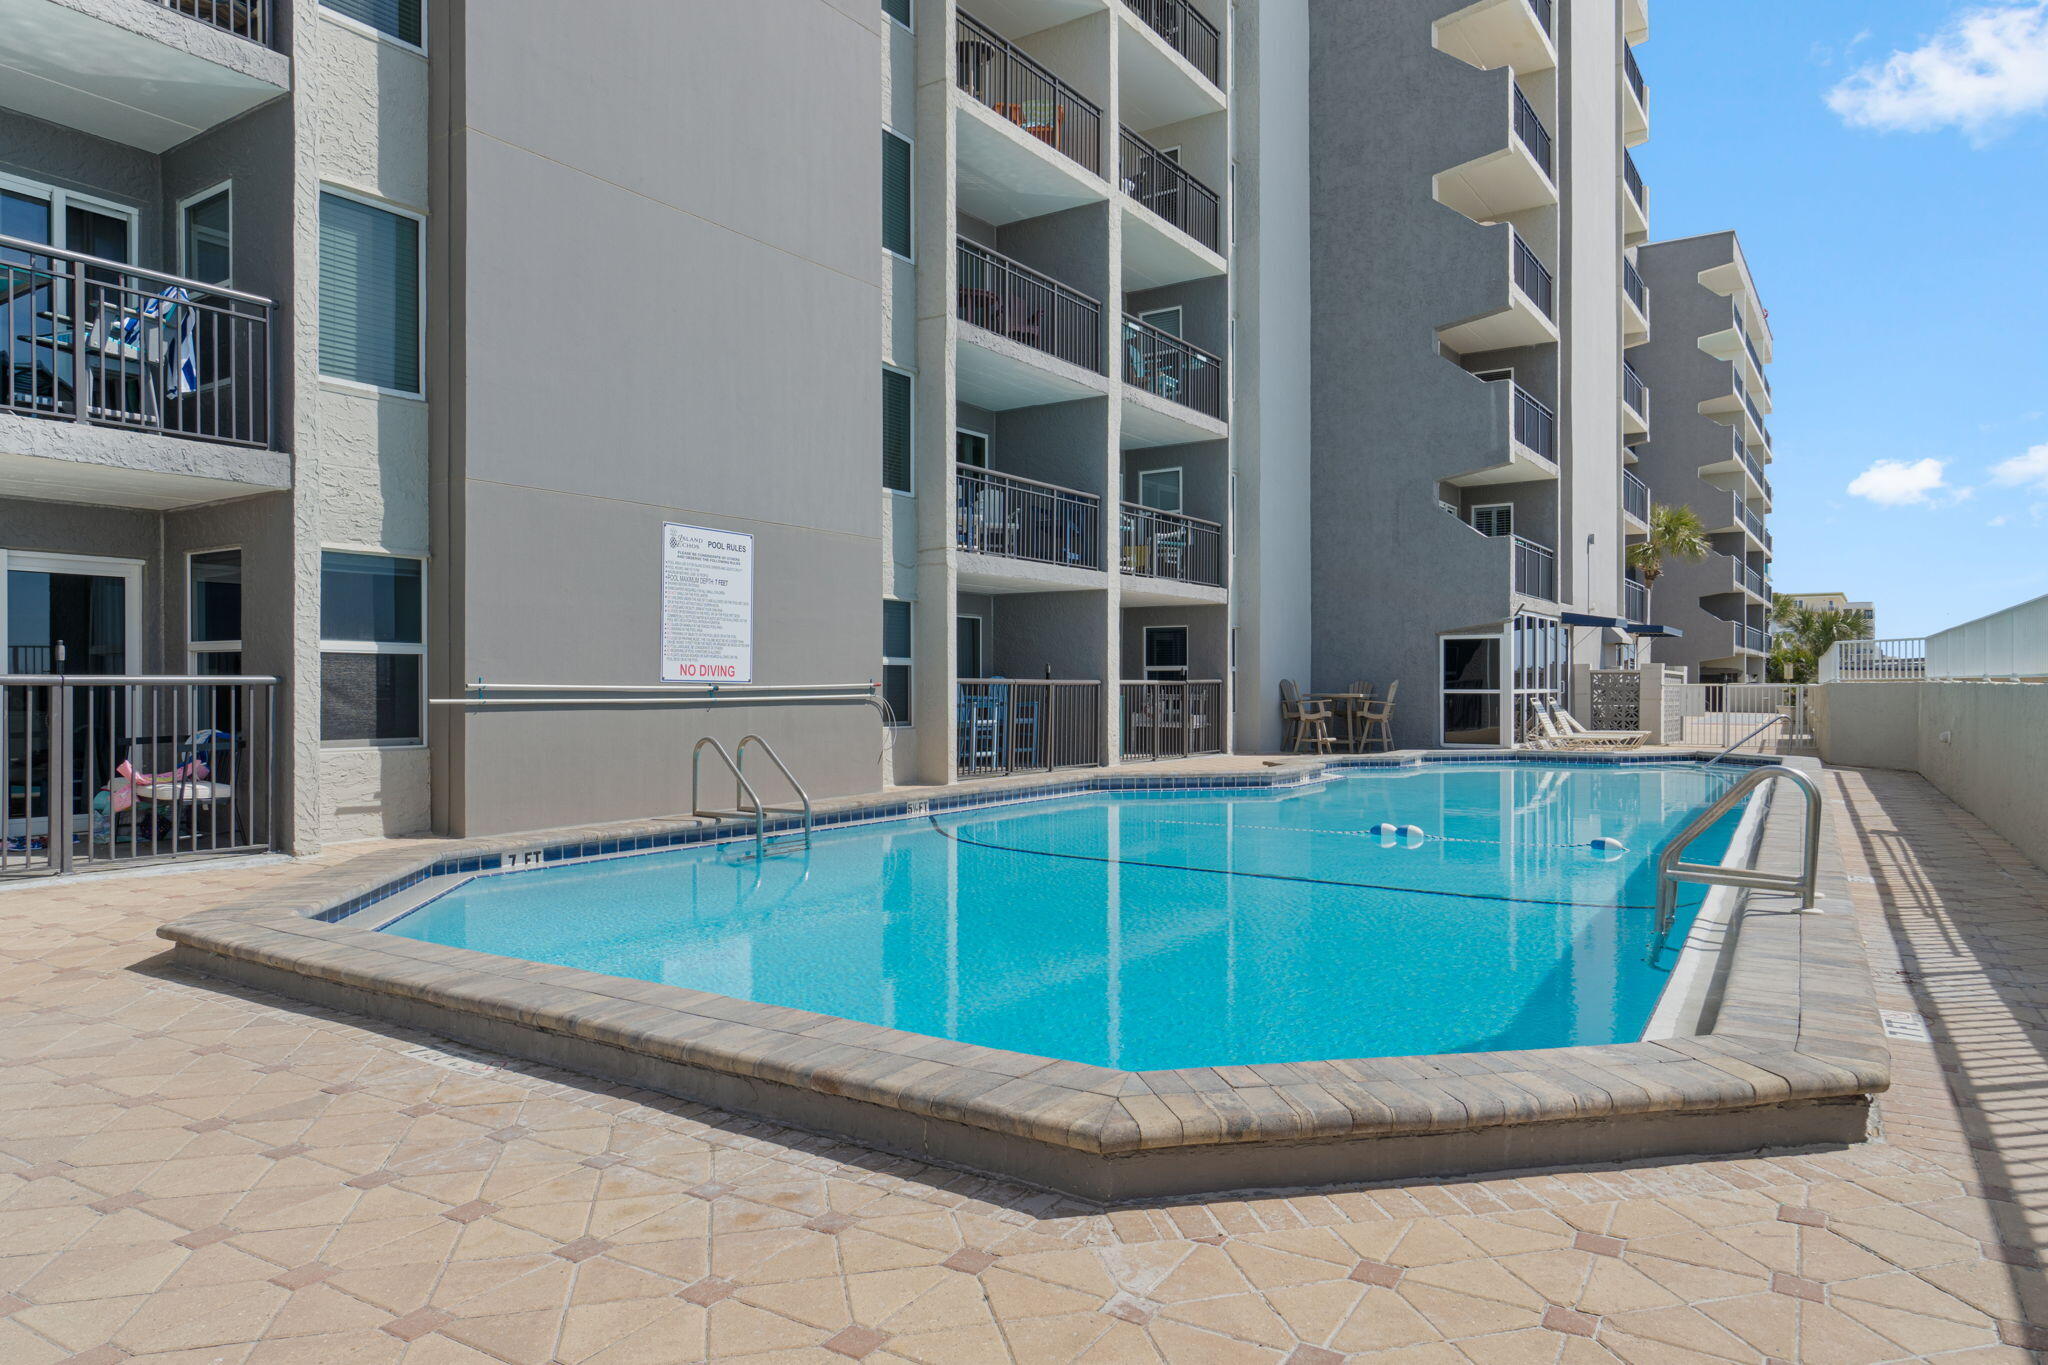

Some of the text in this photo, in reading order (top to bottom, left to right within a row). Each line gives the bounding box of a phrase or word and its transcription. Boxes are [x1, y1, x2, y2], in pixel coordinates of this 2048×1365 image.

[708, 541, 746, 553] POOL RULES
[667, 574, 679, 582] POOL
[680, 575, 699, 584] MAXIMUM
[718, 579, 728, 587] FEET
[680, 664, 736, 678] NO DIVING
[508, 851, 541, 866] 7 FT
